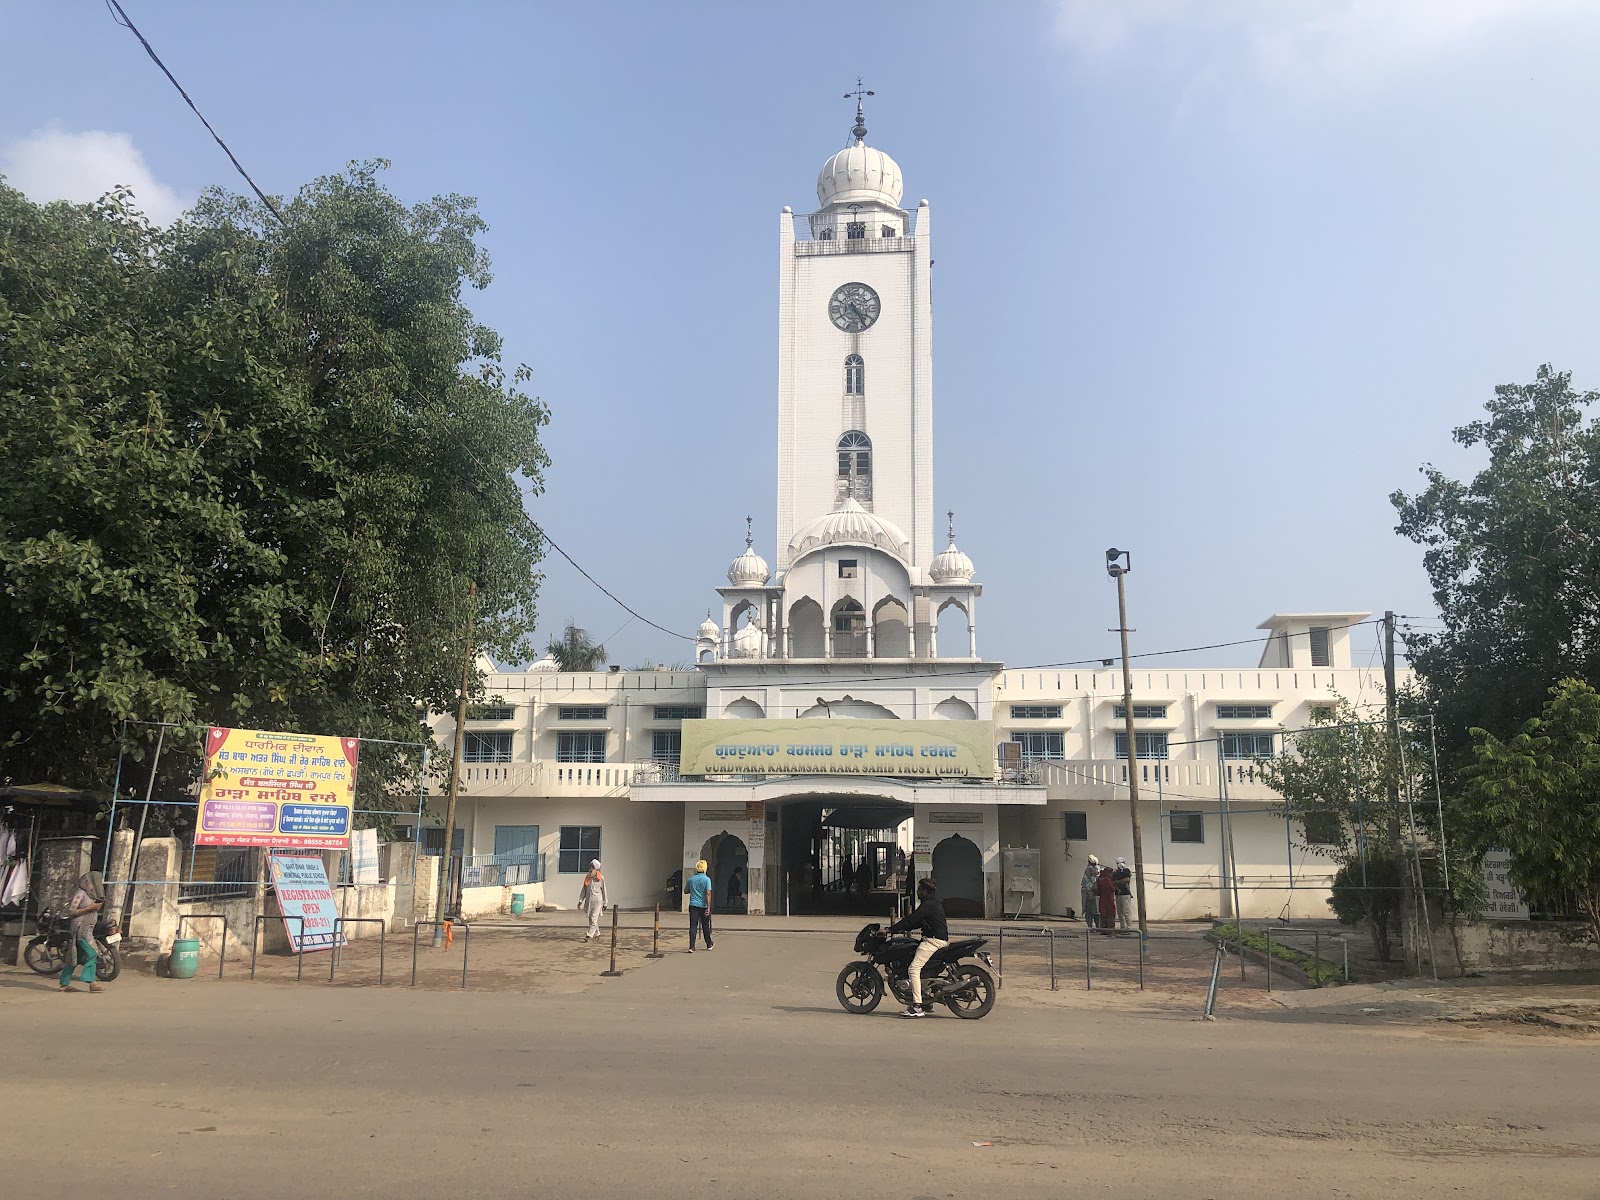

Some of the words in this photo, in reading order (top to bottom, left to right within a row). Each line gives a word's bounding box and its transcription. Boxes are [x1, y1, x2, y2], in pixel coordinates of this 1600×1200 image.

[245, 740, 288, 751] ਧਾਰਮਿਕ
[293, 743, 325, 753] ਦੀਵਾਨ
[715, 744, 780, 759] ਗੁਰਦੁਆਰਾ
[786, 744, 833, 756] ਕਰਮਸਰ
[839, 744, 869, 758] ਰਾੜਾ
[875, 742, 914, 757] ਸਾਹਿਬ
[218, 748, 230, 760] ਸੰਤ
[232, 752, 247, 761] ਬਾਬਾ
[271, 752, 286, 764] ਸਿੰਘ
[289, 753, 297, 765] ਜੀ
[311, 755, 331, 767] ਸਾਹਿਬ
[333, 757, 346, 767] ਵਾਲੇ
[276, 767, 284, 777] ਦੀ
[310, 772, 331, 781] ਰਾਮਪੁਰ
[704, 763, 766, 773] GURDWARA
[767, 763, 827, 773] KARAMSAR
[828, 763, 860, 773] RARA
[862, 764, 895, 774] SAHIB
[897, 764, 931, 774] TRUST
[934, 764, 969, 777] (LDH.)
[215, 788, 250, 799] ਰਾੜਾ
[257, 788, 302, 801] ਸਾਹਿਬ
[309, 791, 337, 803] ਵਾਲੇ
[281, 889, 332, 901] REGISTRATION
[302, 903, 321, 914] OPEN
[303, 916, 331, 928] 2020-21)
